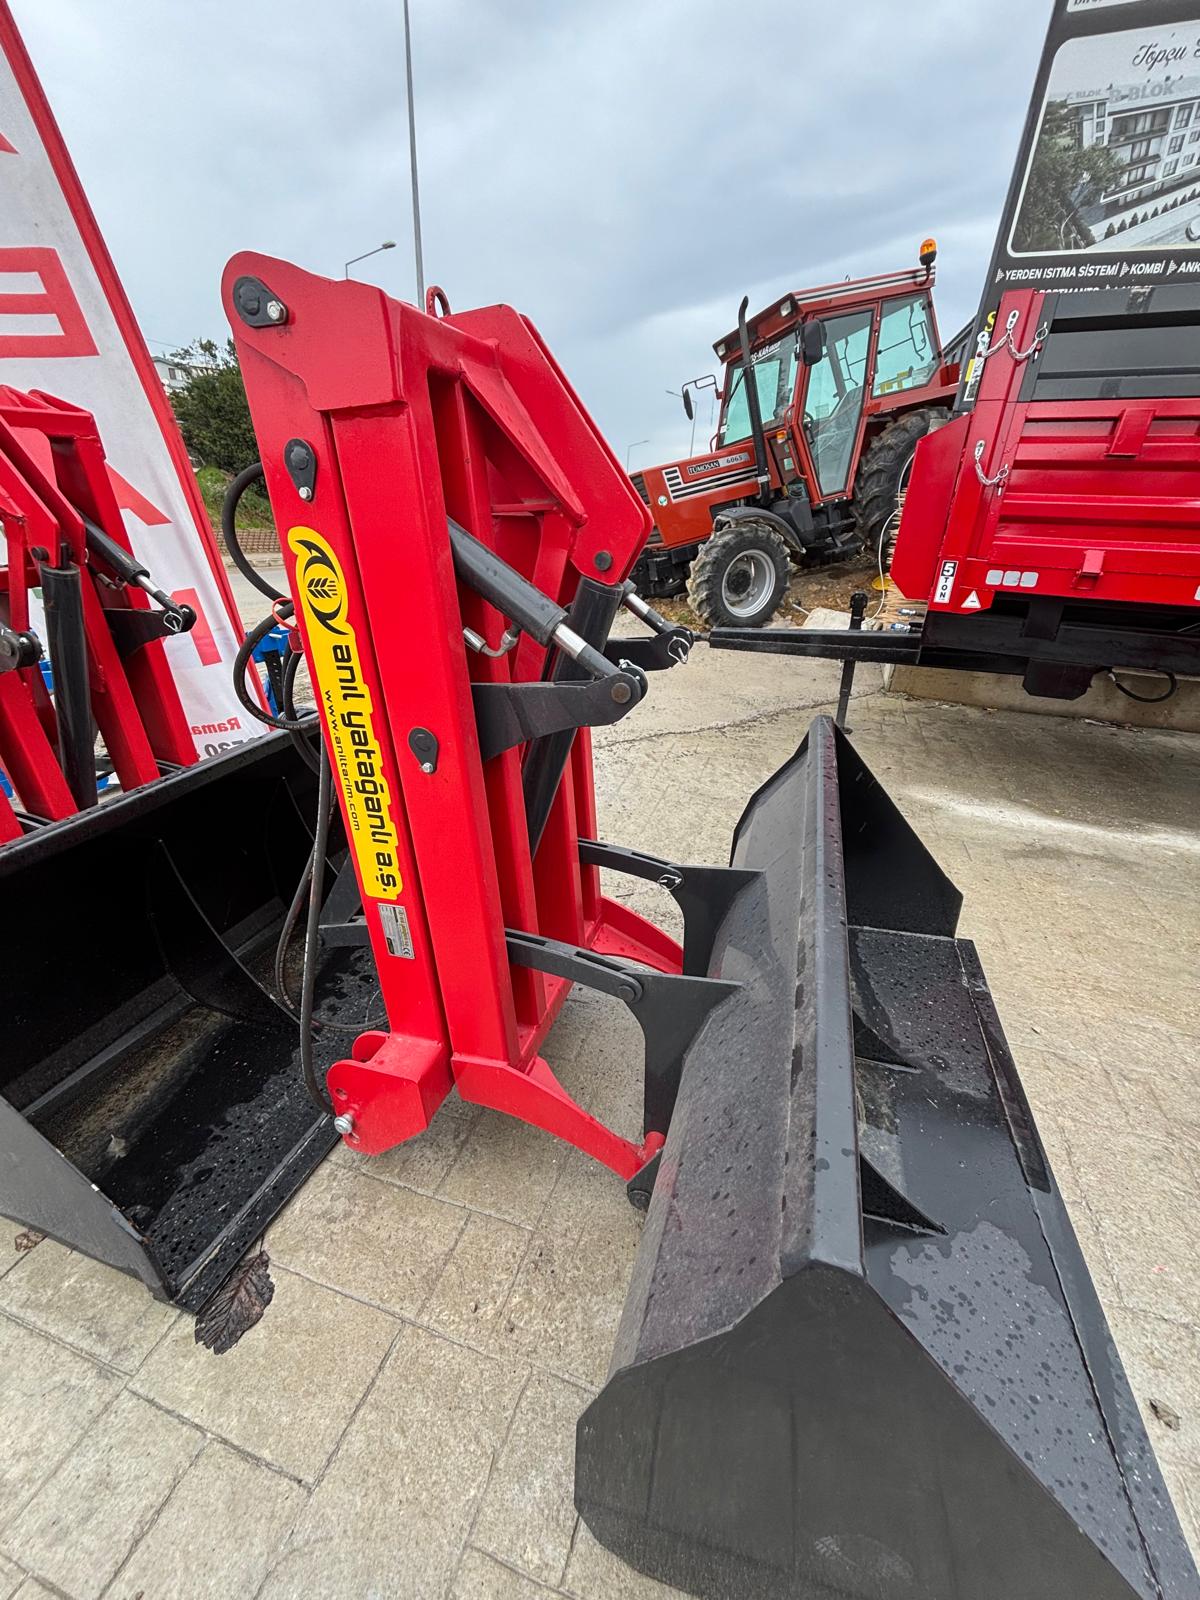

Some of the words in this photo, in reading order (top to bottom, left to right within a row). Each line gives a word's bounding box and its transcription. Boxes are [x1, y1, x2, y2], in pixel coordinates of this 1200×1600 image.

[1005, 267, 1042, 281] YERDEN
[1042, 266, 1076, 279] ISITMA
[1078, 262, 1119, 277] SİSTEMİ
[1129, 260, 1166, 275] KOMBİ
[726, 455, 743, 464] 6065
[943, 562, 955, 576] 5
[940, 577, 949, 598] TON
[340, 711, 393, 844] yatağanlı
